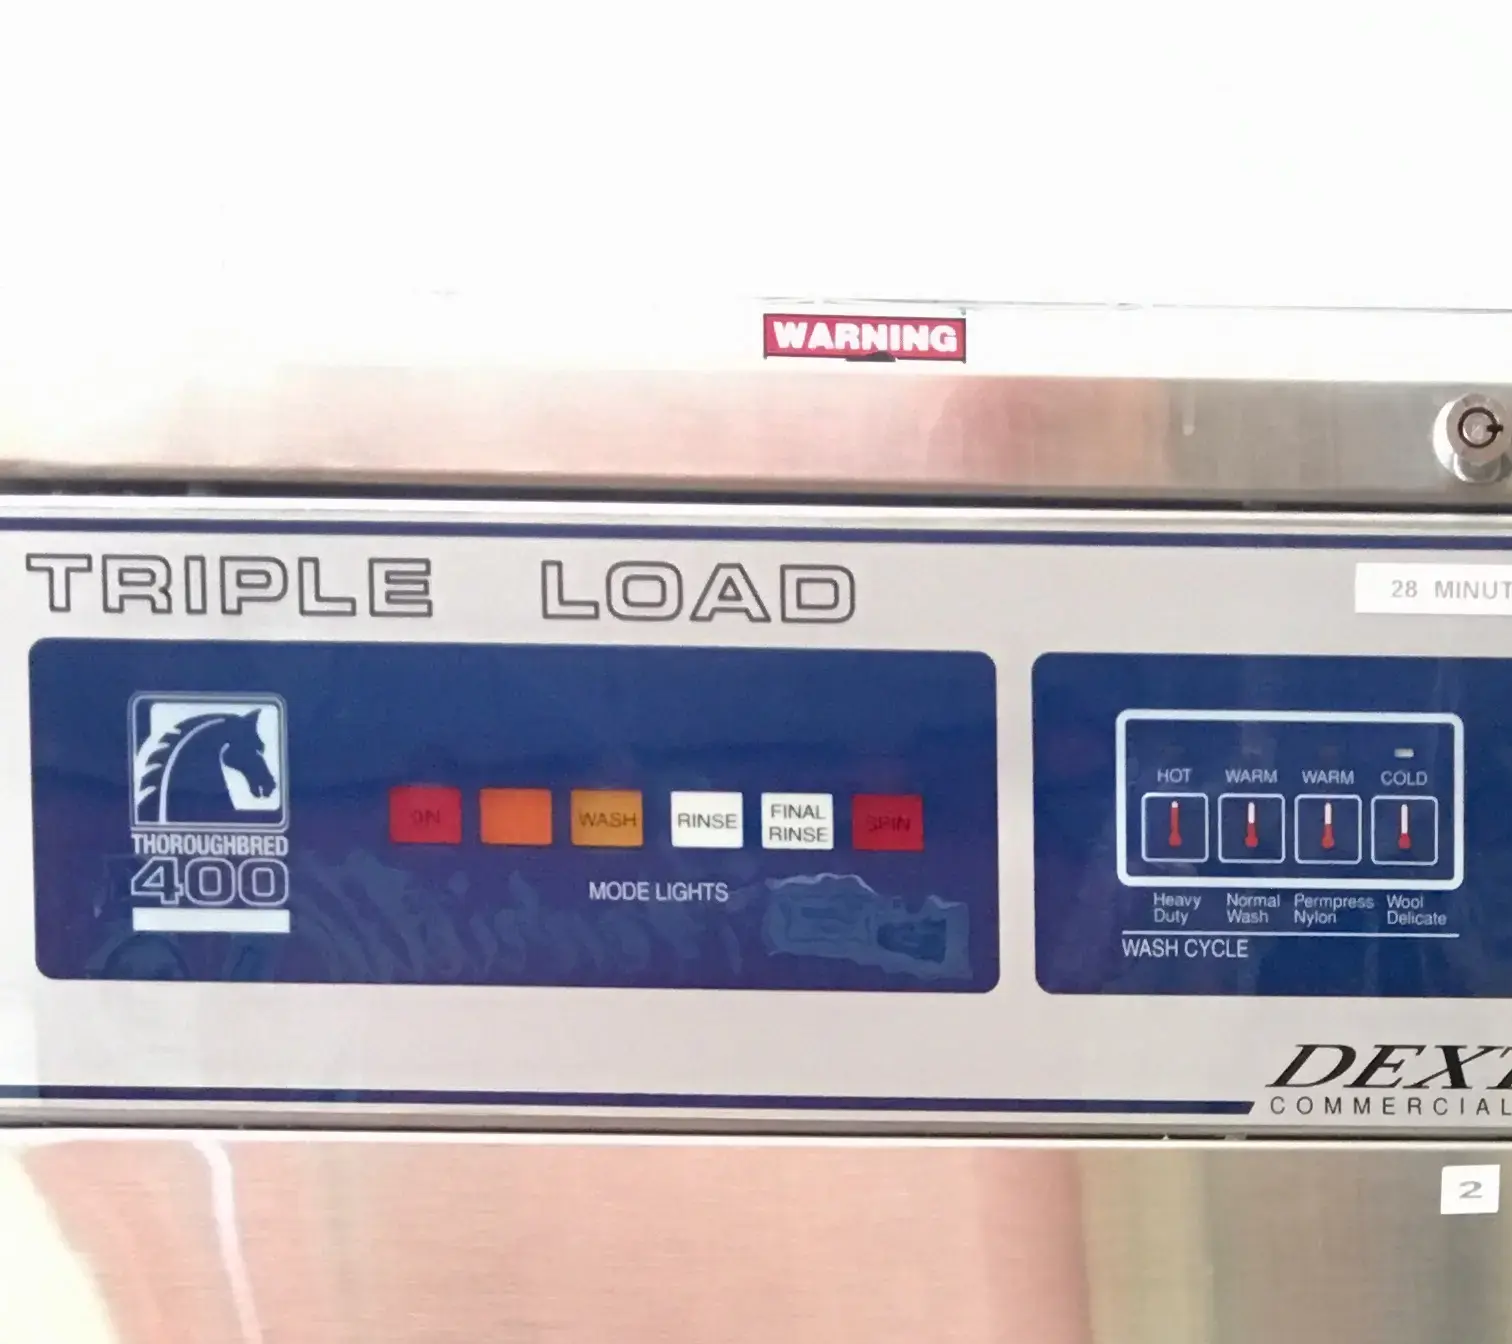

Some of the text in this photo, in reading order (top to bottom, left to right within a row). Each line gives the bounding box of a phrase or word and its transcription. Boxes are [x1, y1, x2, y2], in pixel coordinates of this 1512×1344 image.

[772, 320, 958, 353] WARNING
[26, 553, 856, 624] TRIPLE LOAD
[1391, 580, 1418, 600] 28
[1157, 768, 1193, 784] HOT
[1225, 769, 1278, 784] WARM
[1302, 770, 1355, 785] WARM
[1380, 771, 1428, 787] COLD
[411, 810, 441, 827] ON
[577, 809, 638, 828] WASH
[677, 812, 738, 831] RINSE
[770, 803, 826, 821] FINAL
[867, 814, 911, 834] SPIN
[131, 833, 289, 856] THOROUGHBRED
[768, 826, 829, 845] RINSE
[131, 855, 290, 908] 400
[588, 881, 729, 902] MODE LIGHTS
[1153, 892, 1202, 910] Heavy
[1226, 893, 1280, 908] Normal
[1294, 894, 1375, 913] Permpress
[1386, 895, 1425, 910] Wool
[1153, 908, 1189, 926] Duty
[1226, 909, 1269, 925] Wash
[1293, 910, 1337, 927] Nylon
[1386, 910, 1448, 926] Delicate
[1122, 939, 1250, 958] WASH CYCLE
[1270, 1096, 1512, 1118] COMMERCIAL
[1458, 1180, 1484, 1200] 2
